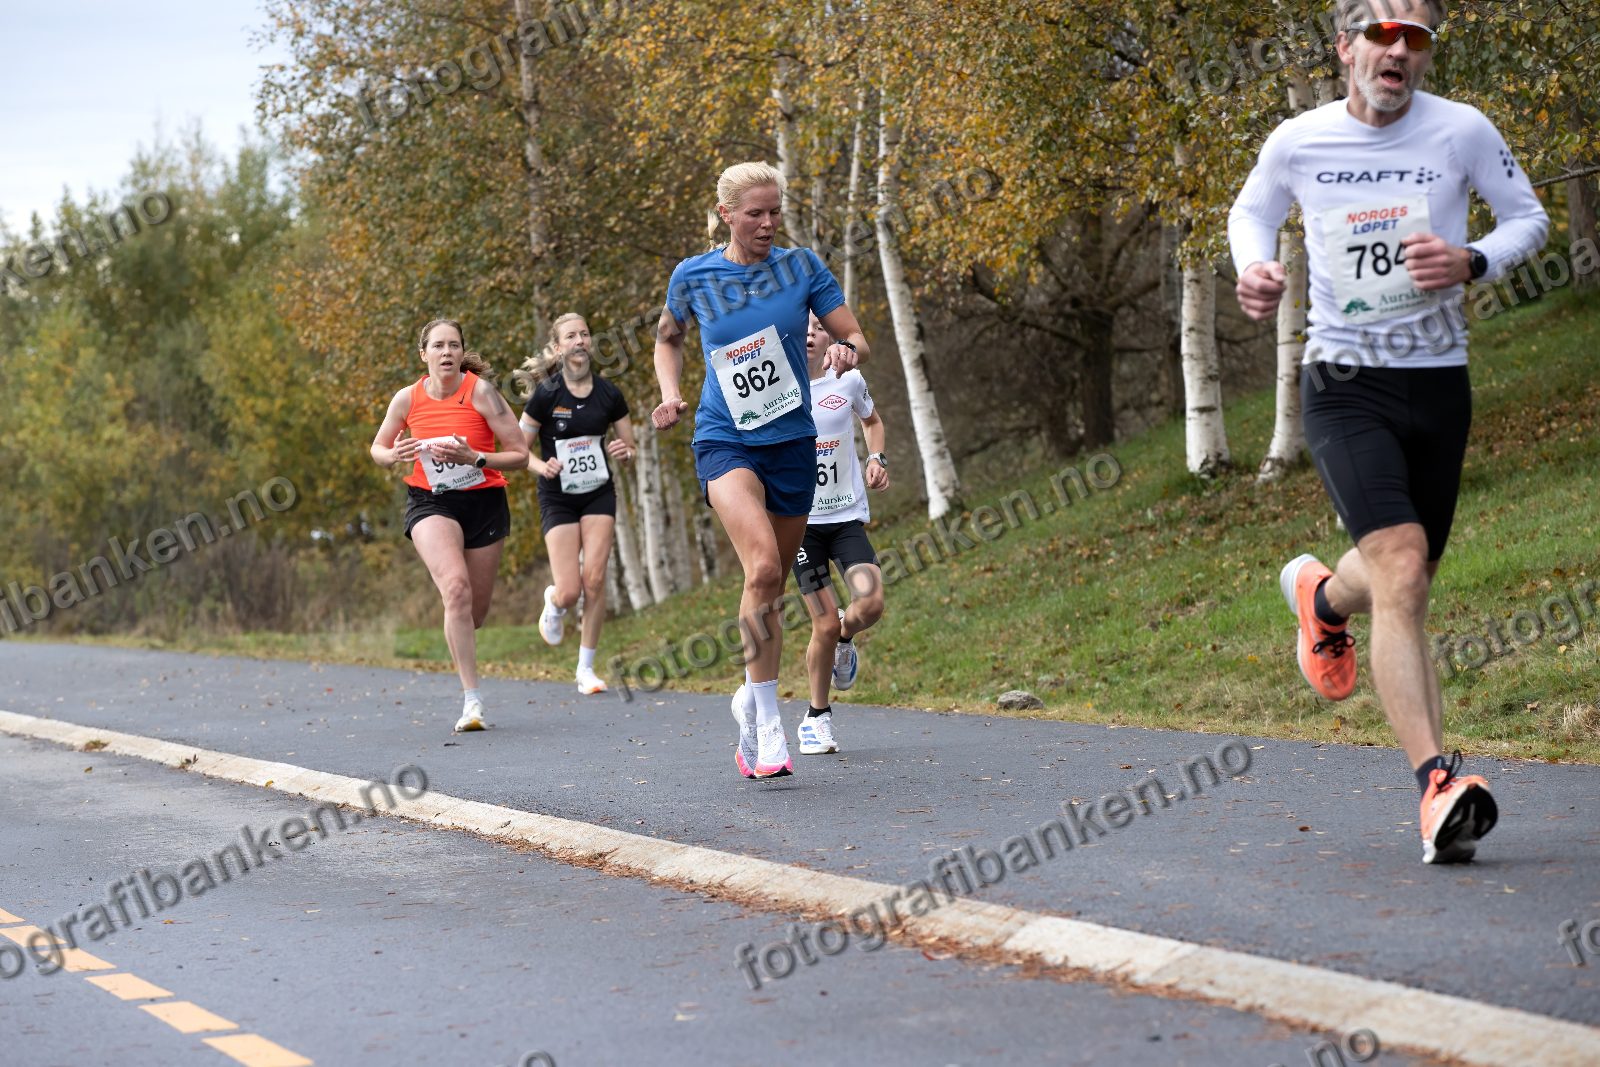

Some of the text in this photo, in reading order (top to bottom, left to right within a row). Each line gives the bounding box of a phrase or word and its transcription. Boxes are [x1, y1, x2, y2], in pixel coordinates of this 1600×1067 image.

[1316, 170, 1412, 184] CRAFT
[1346, 206, 1408, 224] NORGES
[1352, 219, 1399, 235] LØPET
[726, 337, 766, 361] NORGES
[732, 347, 762, 366] LØPET
[733, 360, 780, 399] 962
[763, 387, 800, 412] Aurskog
[816, 440, 840, 450] RGES
[816, 448, 835, 457] PET
[568, 455, 597, 474] 253
[816, 461, 838, 487] 61
[817, 494, 853, 505] Aurskog
